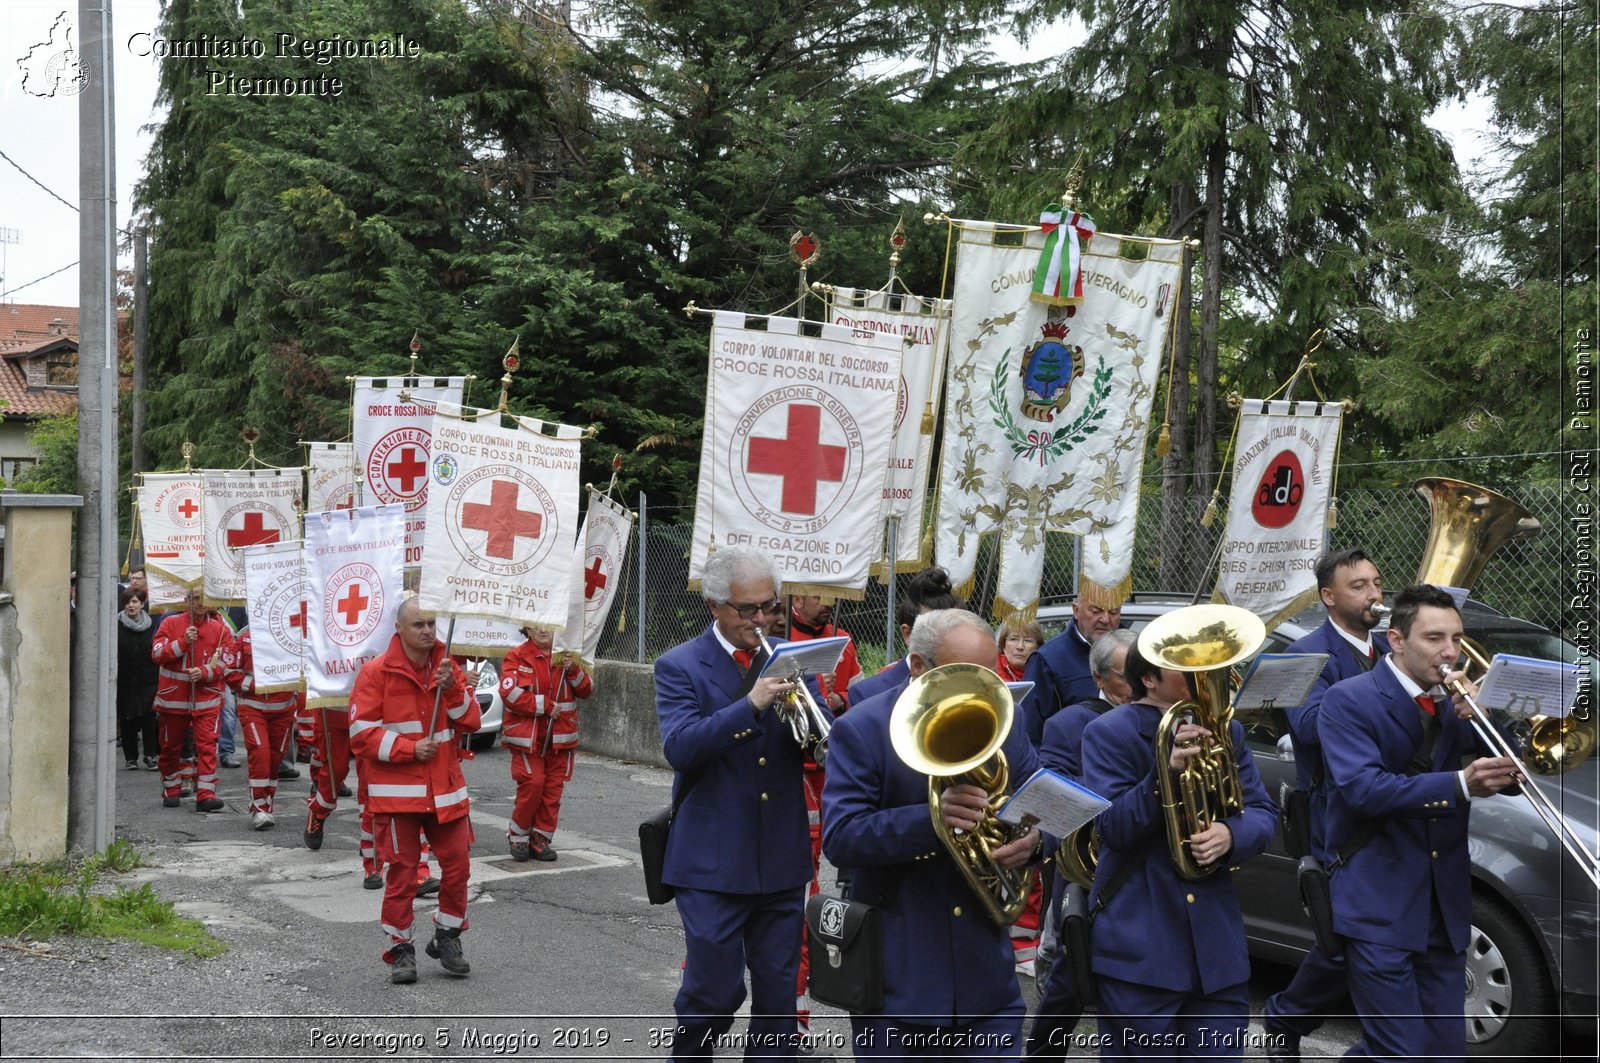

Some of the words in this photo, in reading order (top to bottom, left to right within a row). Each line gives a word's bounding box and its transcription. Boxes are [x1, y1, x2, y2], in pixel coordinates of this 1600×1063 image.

[722, 340, 756, 357] CORPO
[761, 345, 815, 363] VOLONTARI
[818, 352, 836, 368] DEL
[840, 356, 889, 374] SOCCORSO
[713, 356, 768, 376] CROCE
[773, 365, 825, 383] ROSSA
[828, 372, 896, 392] ITALIANA
[368, 405, 392, 417] CROCE
[394, 405, 417, 417] ROSSA
[736, 387, 813, 437] CONVENZIONE
[817, 390, 827, 402] DI
[828, 399, 861, 449] GINEVRA
[1270, 425, 1297, 441] ITALIANA
[439, 427, 467, 442] CORPO
[469, 433, 513, 448] VOLONTARI
[517, 440, 531, 452] DEL
[534, 442, 574, 459] SOCCORSO
[371, 430, 413, 479] CONVENZIONE
[416, 431, 423, 443] DI
[433, 439, 477, 456] CROCE
[481, 449, 523, 463] ROSSA
[527, 455, 579, 471] ITALIANA
[208, 481, 227, 489] CORPO
[227, 481, 256, 489] VOLONTARI
[258, 481, 270, 489] DEL
[271, 480, 298, 489] SOCCORSO
[451, 466, 511, 501] CONVENZIONE
[514, 470, 524, 480] DI
[525, 478, 555, 515] GINEVRA
[1259, 465, 1303, 507] aido
[154, 489, 171, 513] CROCE
[171, 481, 197, 491] ROSSA
[204, 489, 233, 499] CROCE
[235, 490, 265, 499] ROSSA
[380, 489, 389, 501] 22
[219, 502, 256, 530] CONVENZIONE
[167, 534, 201, 542] GRUPPO
[338, 542, 362, 554] ROSSA
[363, 538, 397, 552] ITALIANA
[148, 544, 191, 552] VILLANOVA
[835, 542, 849, 555] DI
[251, 561, 272, 571] CORPO
[273, 558, 305, 569] VOLONTARI
[1288, 558, 1317, 571] PESIO
[447, 575, 499, 590] COMITATO
[510, 585, 550, 600] LOCALE
[253, 582, 279, 619] CROCE
[280, 593, 290, 602] DI
[454, 589, 536, 612] MORETTA
[465, 631, 508, 640] DRONERO
[264, 663, 299, 675] GRUPPO
